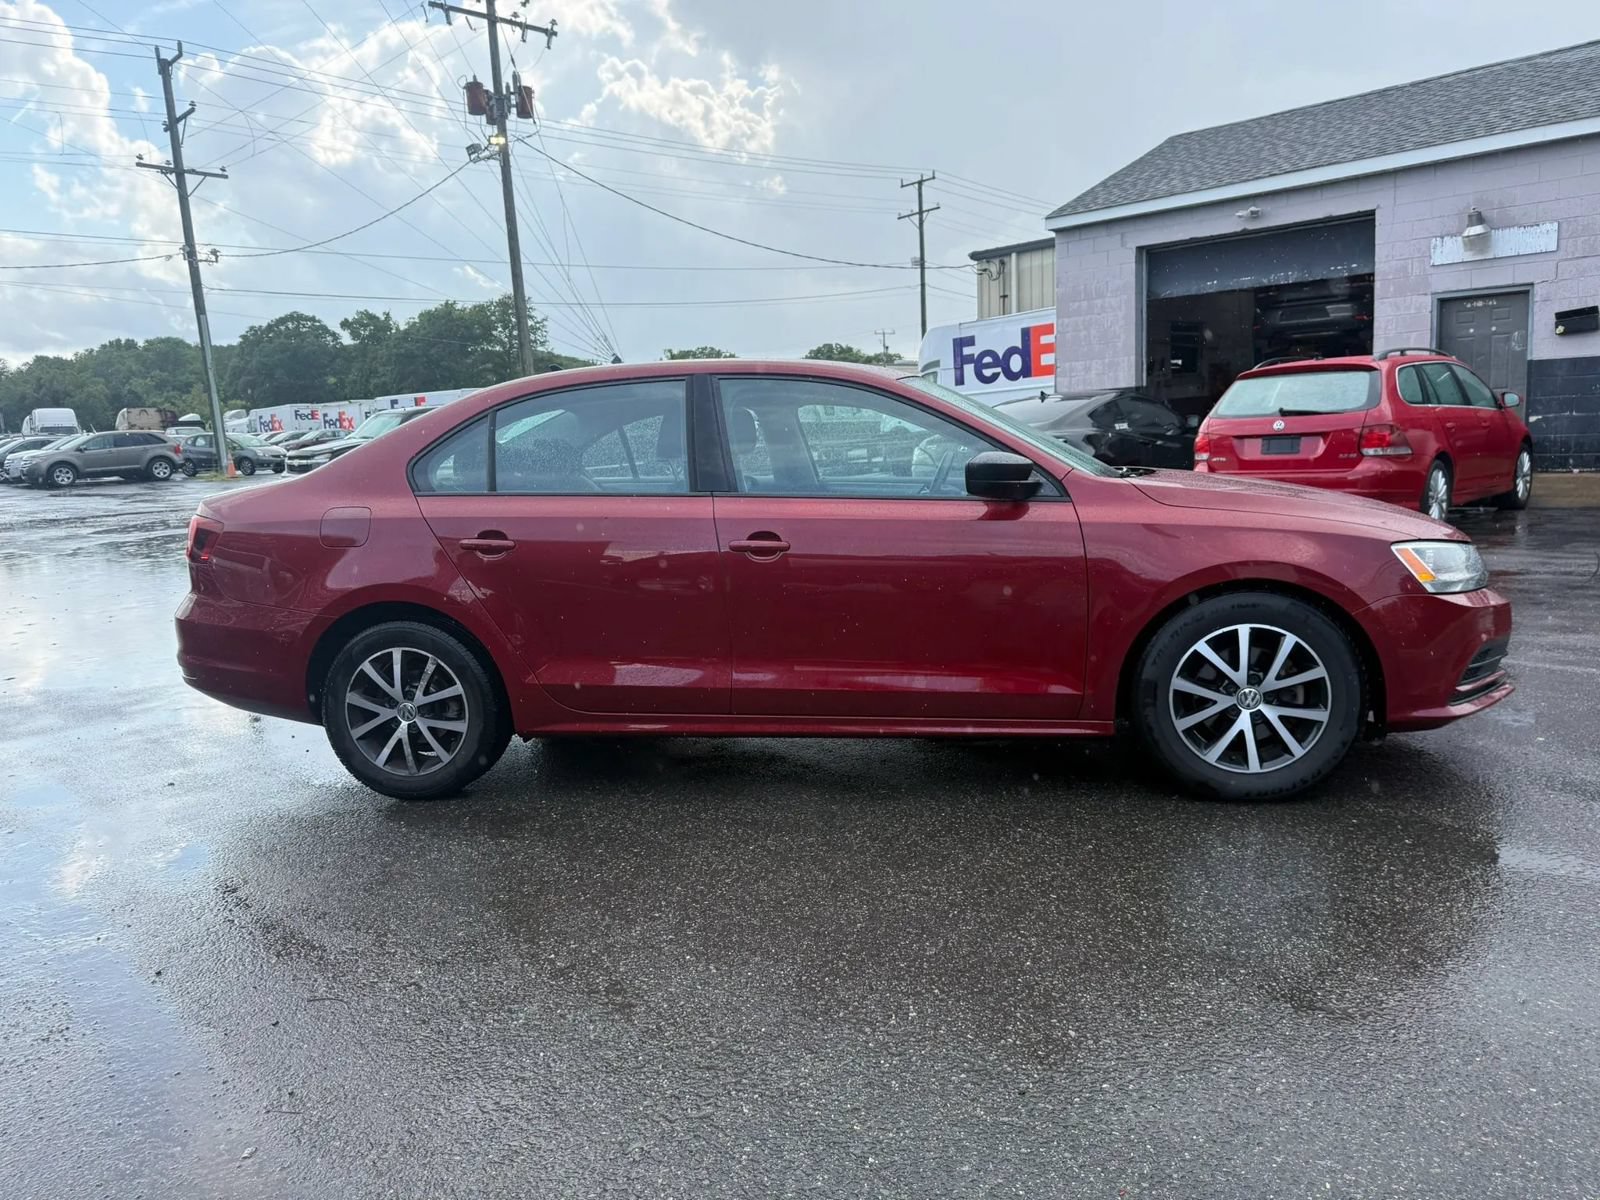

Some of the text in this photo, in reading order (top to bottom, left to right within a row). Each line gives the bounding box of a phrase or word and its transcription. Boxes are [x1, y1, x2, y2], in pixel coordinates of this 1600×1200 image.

[952, 323, 1056, 387] FedE
[258, 413, 284, 433] FedEx
[294, 409, 320, 421] FedE
[322, 410, 355, 430] FedEx
